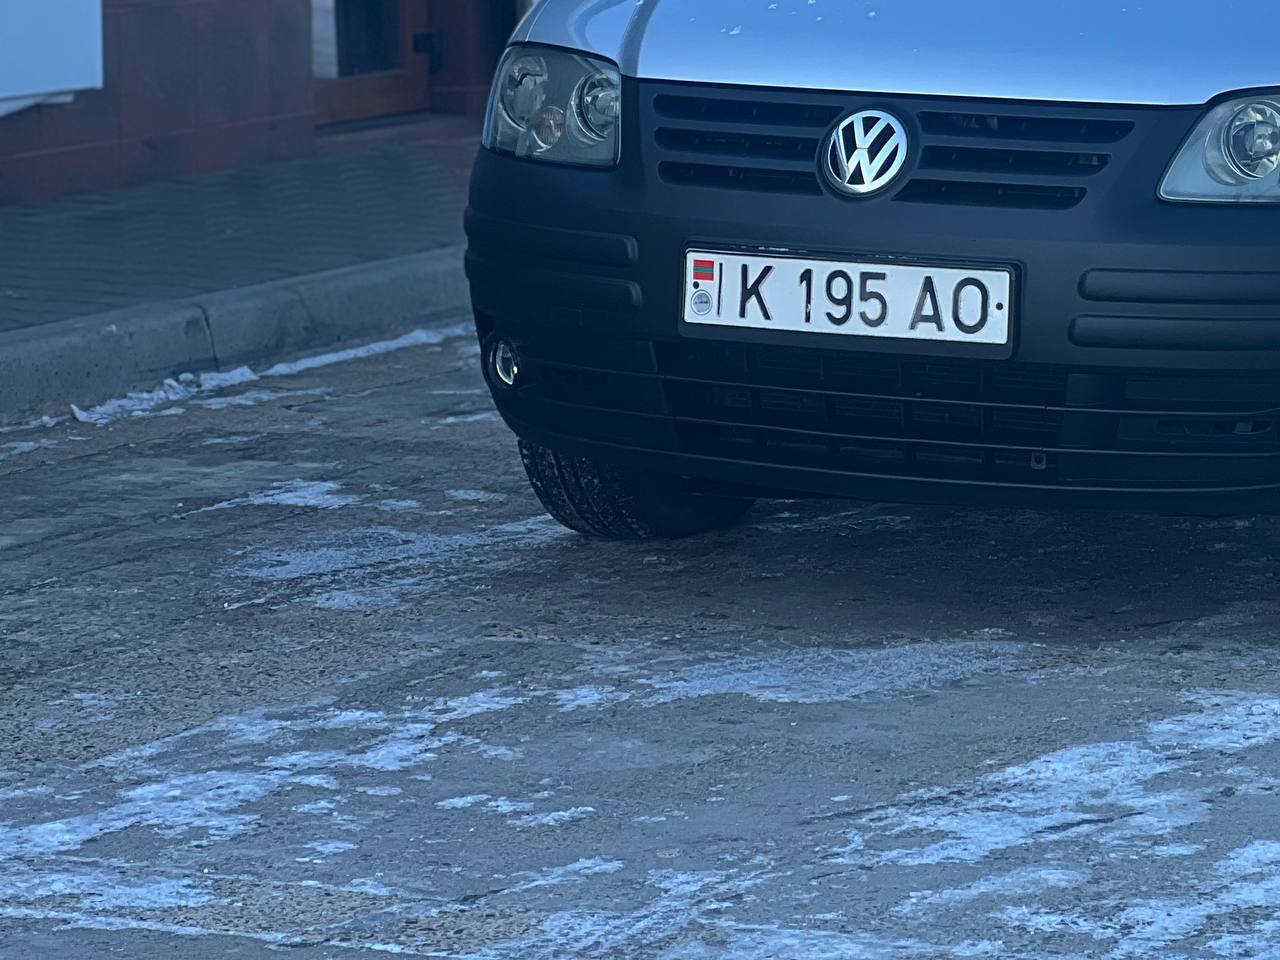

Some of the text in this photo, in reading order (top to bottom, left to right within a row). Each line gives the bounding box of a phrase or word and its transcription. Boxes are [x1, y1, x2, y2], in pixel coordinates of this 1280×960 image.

[739, 264, 989, 334] K 195 AO
